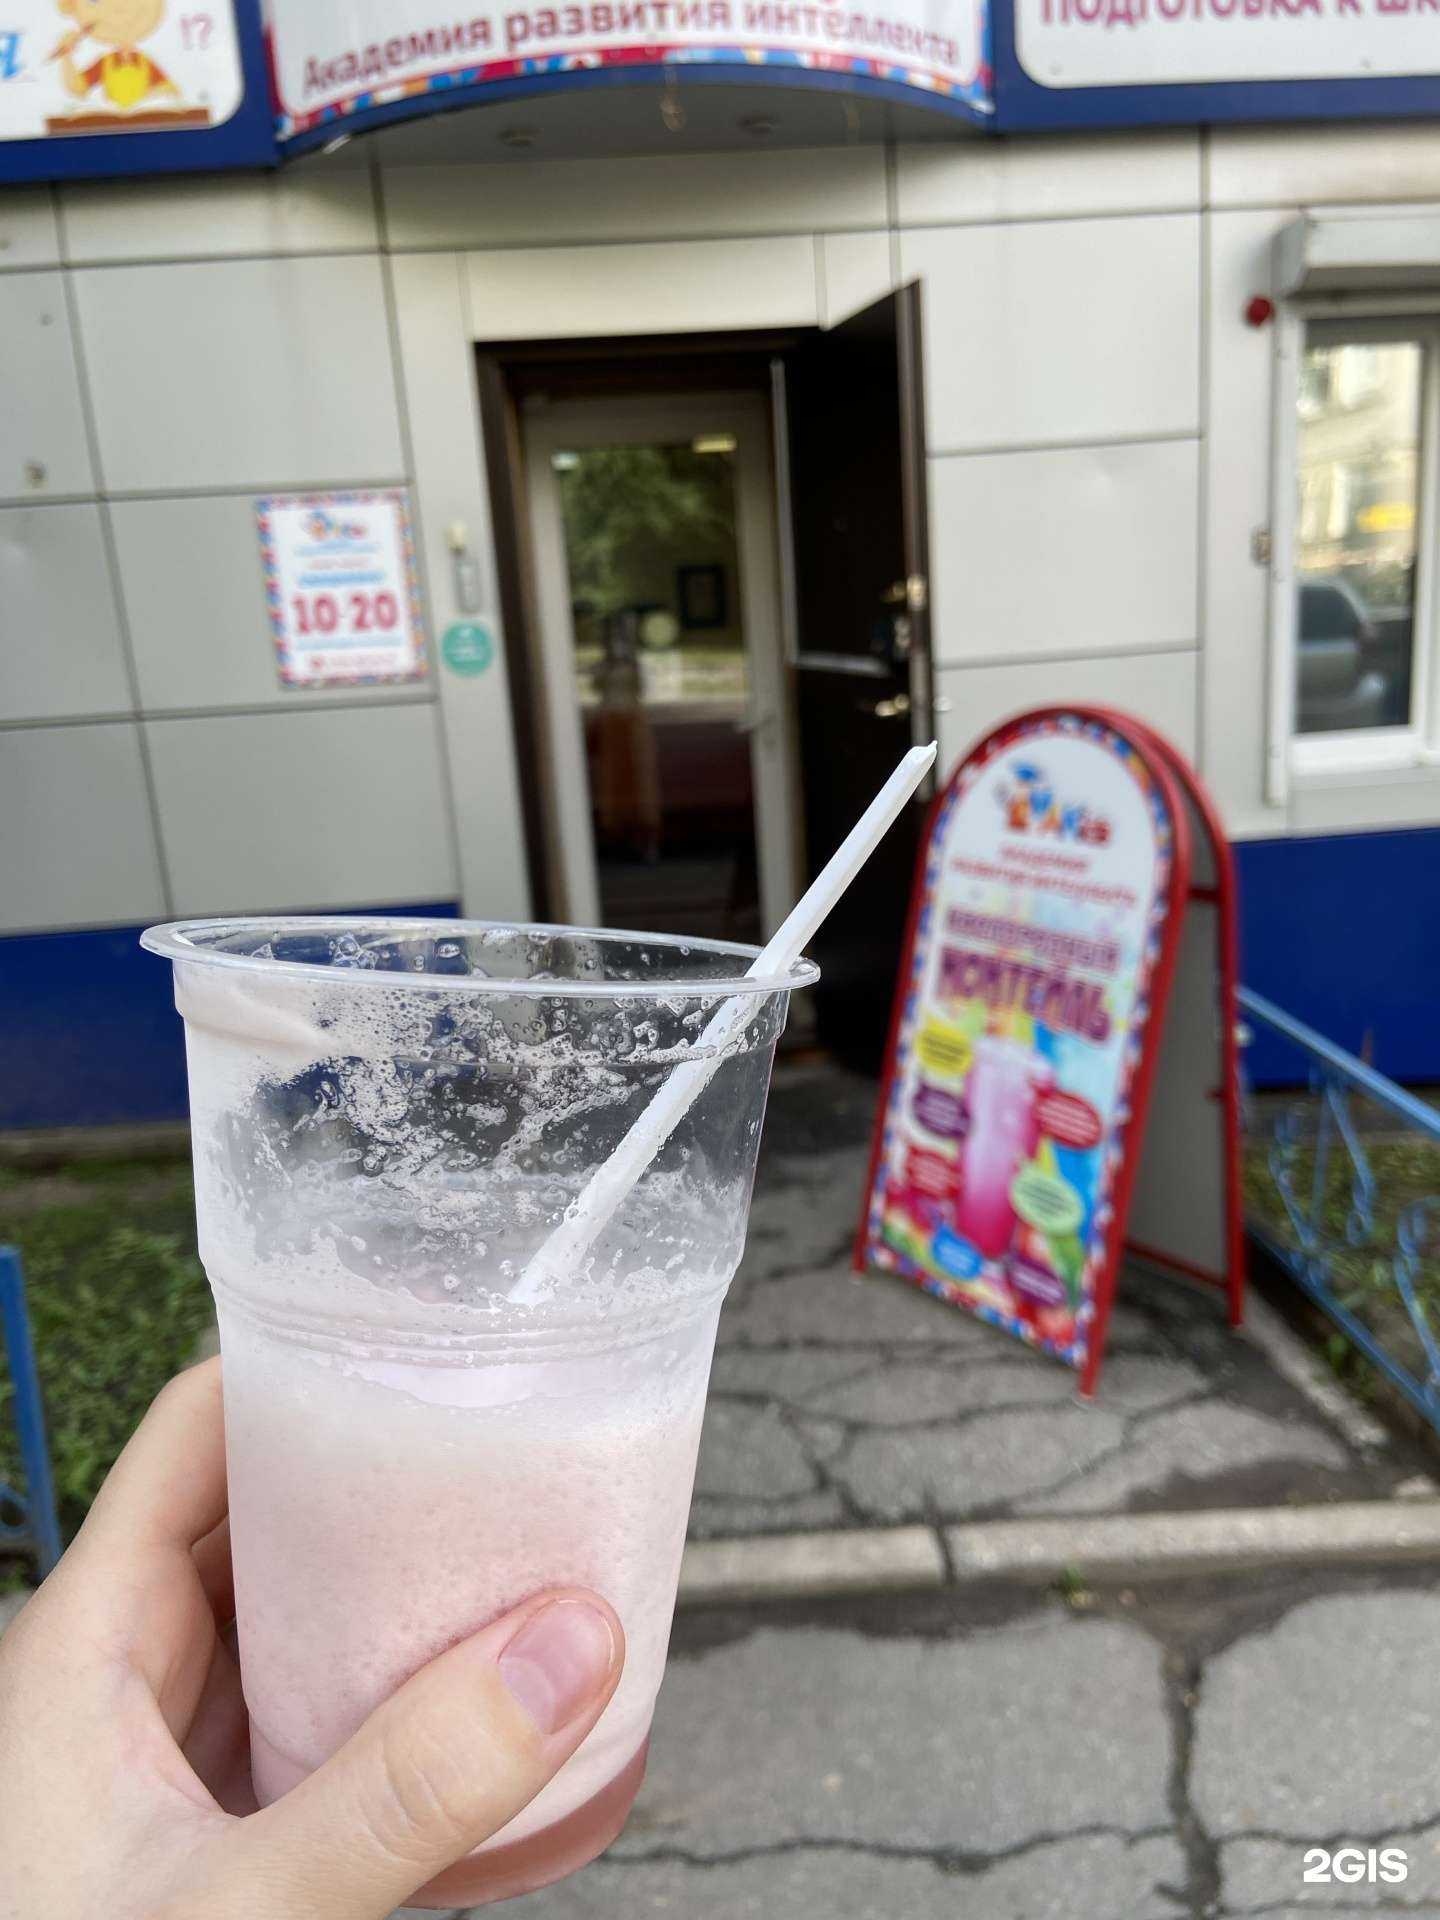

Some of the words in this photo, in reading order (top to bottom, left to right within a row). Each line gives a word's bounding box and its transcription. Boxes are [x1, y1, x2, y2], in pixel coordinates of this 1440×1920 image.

[302, 17, 491, 92] Академия
[505, 0, 731, 52] развития
[744, 3, 959, 64] интеллекта
[292, 593, 338, 636] 10
[351, 592, 397, 632] 20
